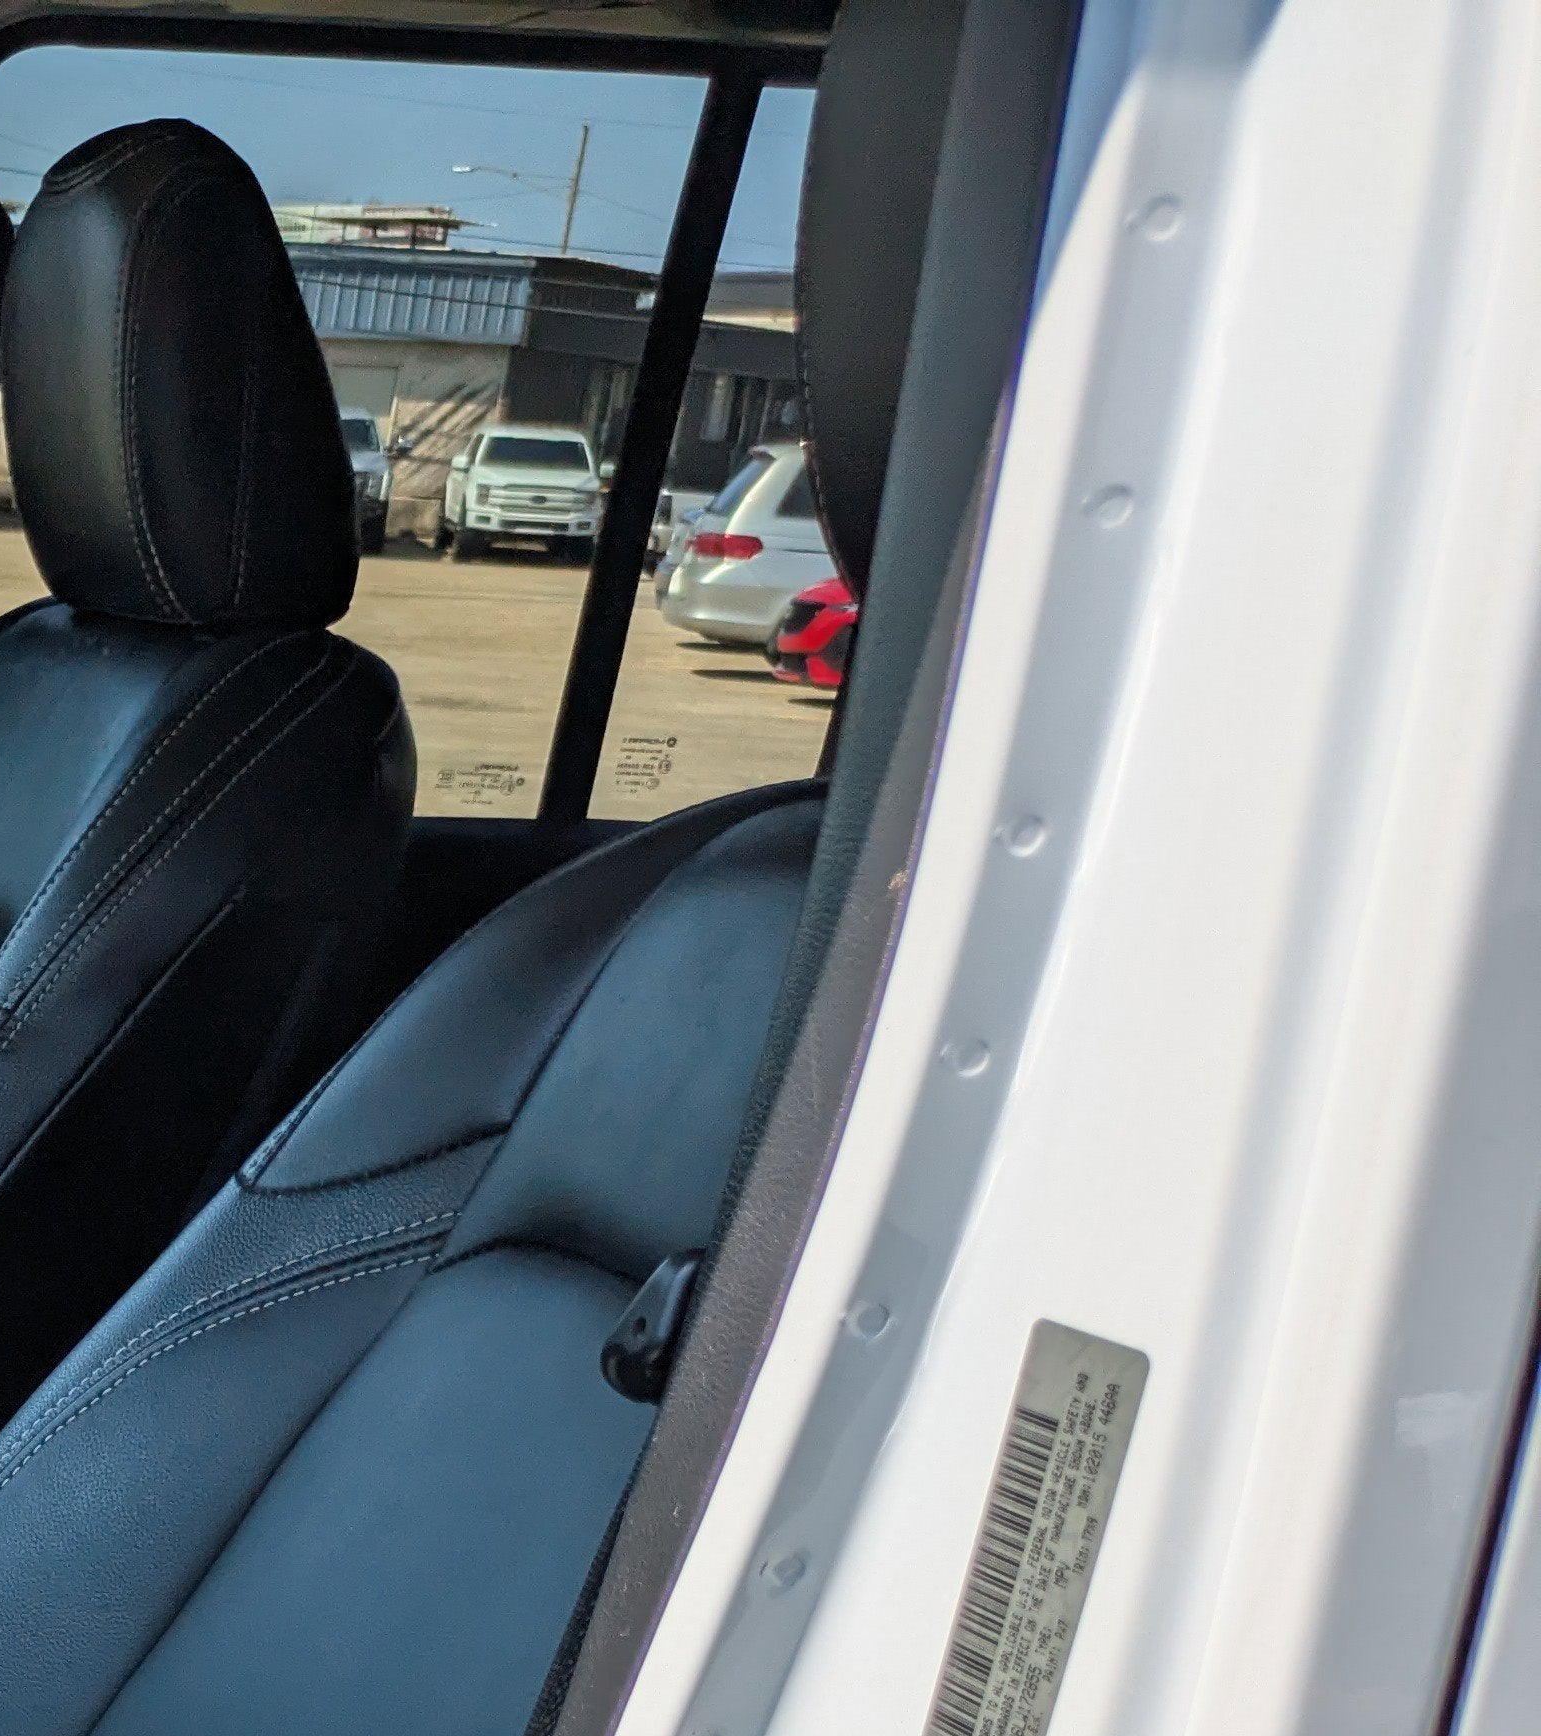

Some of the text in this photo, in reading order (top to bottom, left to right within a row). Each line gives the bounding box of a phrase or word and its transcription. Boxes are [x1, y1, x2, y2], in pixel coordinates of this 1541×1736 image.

[1072, 1370, 1089, 1393] AND
[1061, 1395, 1083, 1436] SAFETY
[1047, 1438, 1071, 1485] VEHICLE
[1066, 1437, 1087, 1471] SHOWN
[1038, 1486, 1058, 1521] MOTOR
[1046, 1474, 1077, 1544] MANUFACTURE
[1025, 1523, 1048, 1569] FEDERAL
[1042, 1546, 1056, 1562] OF
[1033, 1564, 1052, 1592] DATE
[1050, 1558, 1073, 1590] MPV
[1027, 1594, 1043, 1615] THE
[1022, 1616, 1037, 1634] ON
[996, 1611, 1023, 1674] APPLICABLE
[1011, 1635, 1032, 1675] EFFECT
[990, 1676, 1005, 1697] ALL
[1006, 1676, 1020, 1691] IN
[985, 1698, 999, 1714] TO
